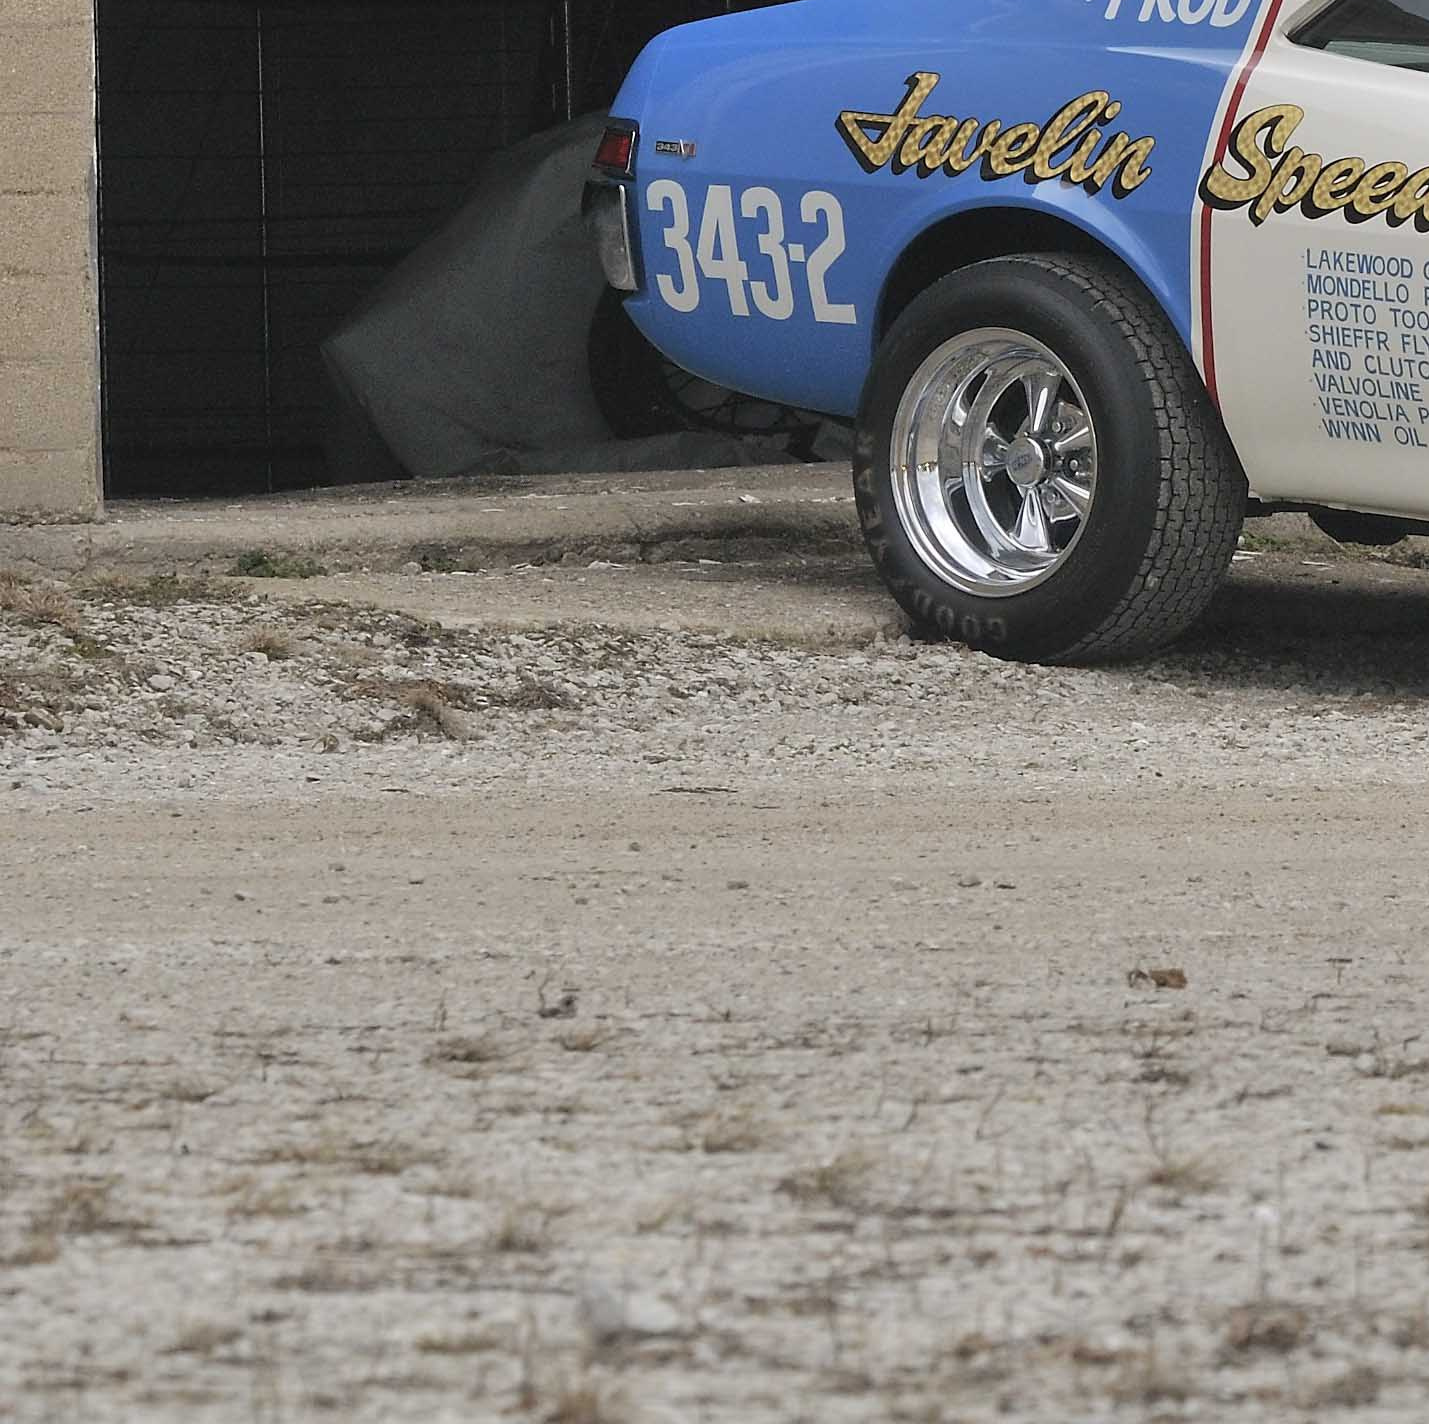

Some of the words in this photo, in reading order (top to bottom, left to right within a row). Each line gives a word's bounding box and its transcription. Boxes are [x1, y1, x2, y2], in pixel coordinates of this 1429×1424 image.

[834, 71, 1157, 199] Javelin
[646, 179, 857, 324] 343-2
[1307, 248, 1413, 279] LAKEWOOD
[1307, 274, 1409, 303] MONDELLO
[1308, 299, 1376, 325] PROTO
[1309, 325, 1389, 351] SHIEFFR
[1312, 349, 1351, 371] AND
[1314, 373, 1423, 402] VALVOLINE
[1319, 396, 1410, 422] VENOLIA
[1322, 419, 1382, 443] WYNN
[1394, 426, 1427, 447] OIL
